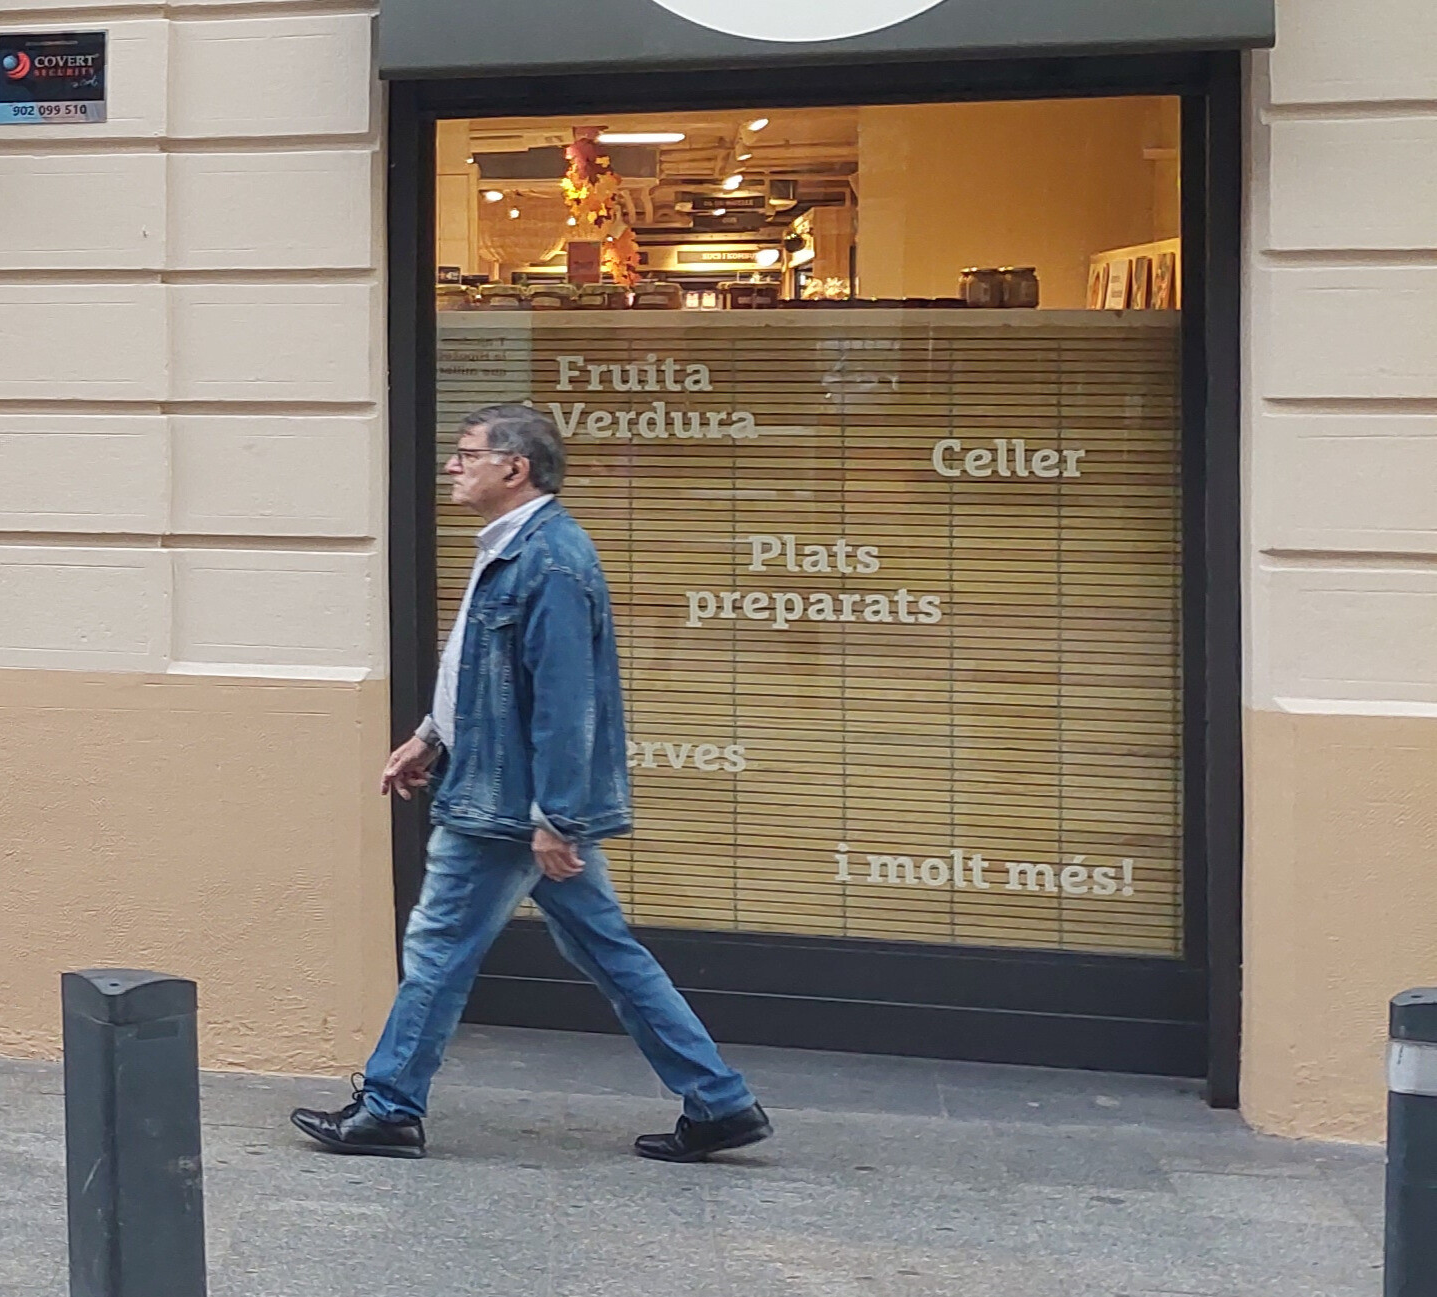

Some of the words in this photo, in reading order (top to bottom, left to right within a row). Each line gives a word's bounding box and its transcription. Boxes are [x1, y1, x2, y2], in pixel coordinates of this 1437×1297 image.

[34, 54, 95, 68] COVERT
[12, 105, 35, 117] 902
[38, 105, 61, 116] 099
[64, 104, 87, 115] 510
[555, 354, 713, 391] Fruita
[547, 401, 759, 439] Verdura
[931, 438, 1086, 479] Celler
[747, 535, 881, 574] Plats
[686, 586, 943, 630] preparats
[835, 843, 851, 883] i
[867, 849, 991, 890] molt
[1005, 855, 1136, 897] més!
